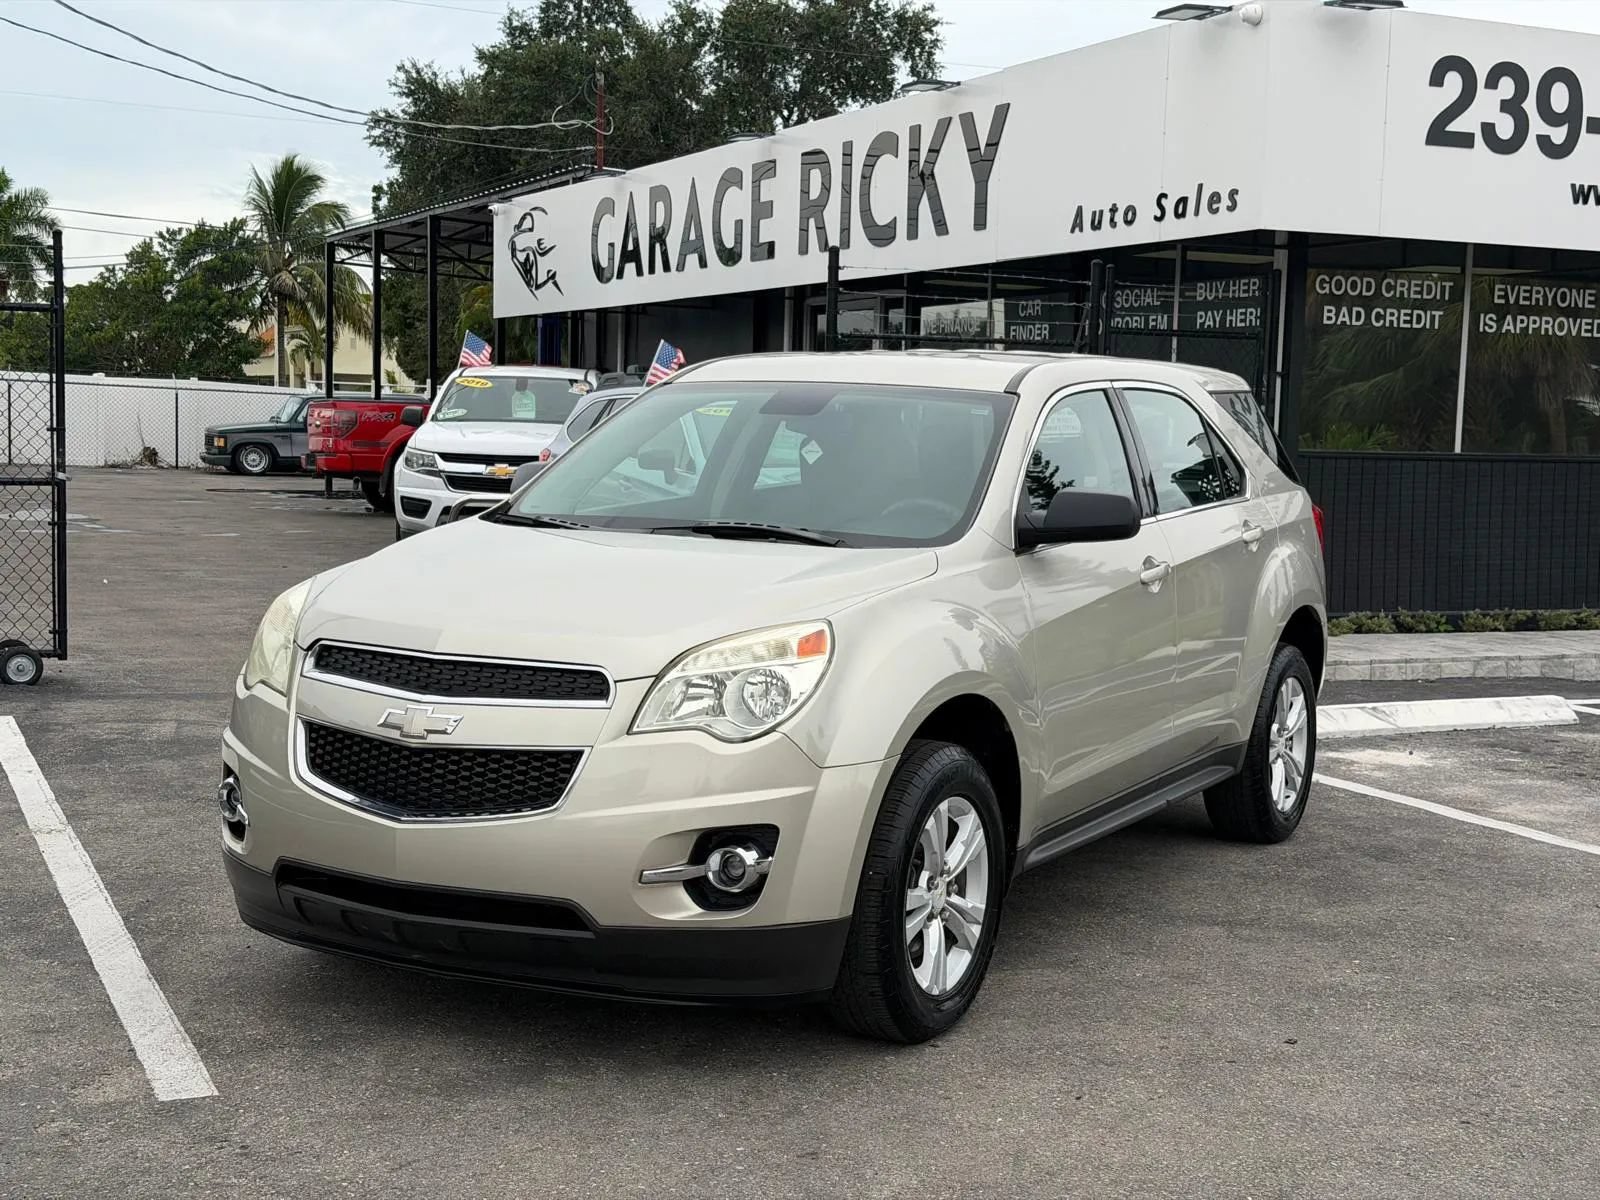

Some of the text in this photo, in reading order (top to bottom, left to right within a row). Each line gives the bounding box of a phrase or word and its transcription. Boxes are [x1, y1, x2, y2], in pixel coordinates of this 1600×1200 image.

[591, 102, 1011, 285] GARAGE RICKY
[1069, 183, 1240, 235] Auto Sales
[1113, 287, 1161, 309] SOCIAL
[1196, 278, 1262, 301] BUY HER
[1315, 274, 1454, 301] GOOD CREDIT
[1493, 284, 1597, 309] EVERYONE
[1018, 299, 1042, 317] CAR
[1322, 305, 1444, 330] BAD CREDIT
[938, 317, 981, 334] FINANCE
[1196, 310, 1223, 329] PAY
[1479, 313, 1497, 333] IS
[1010, 324, 1050, 341] FINDER
